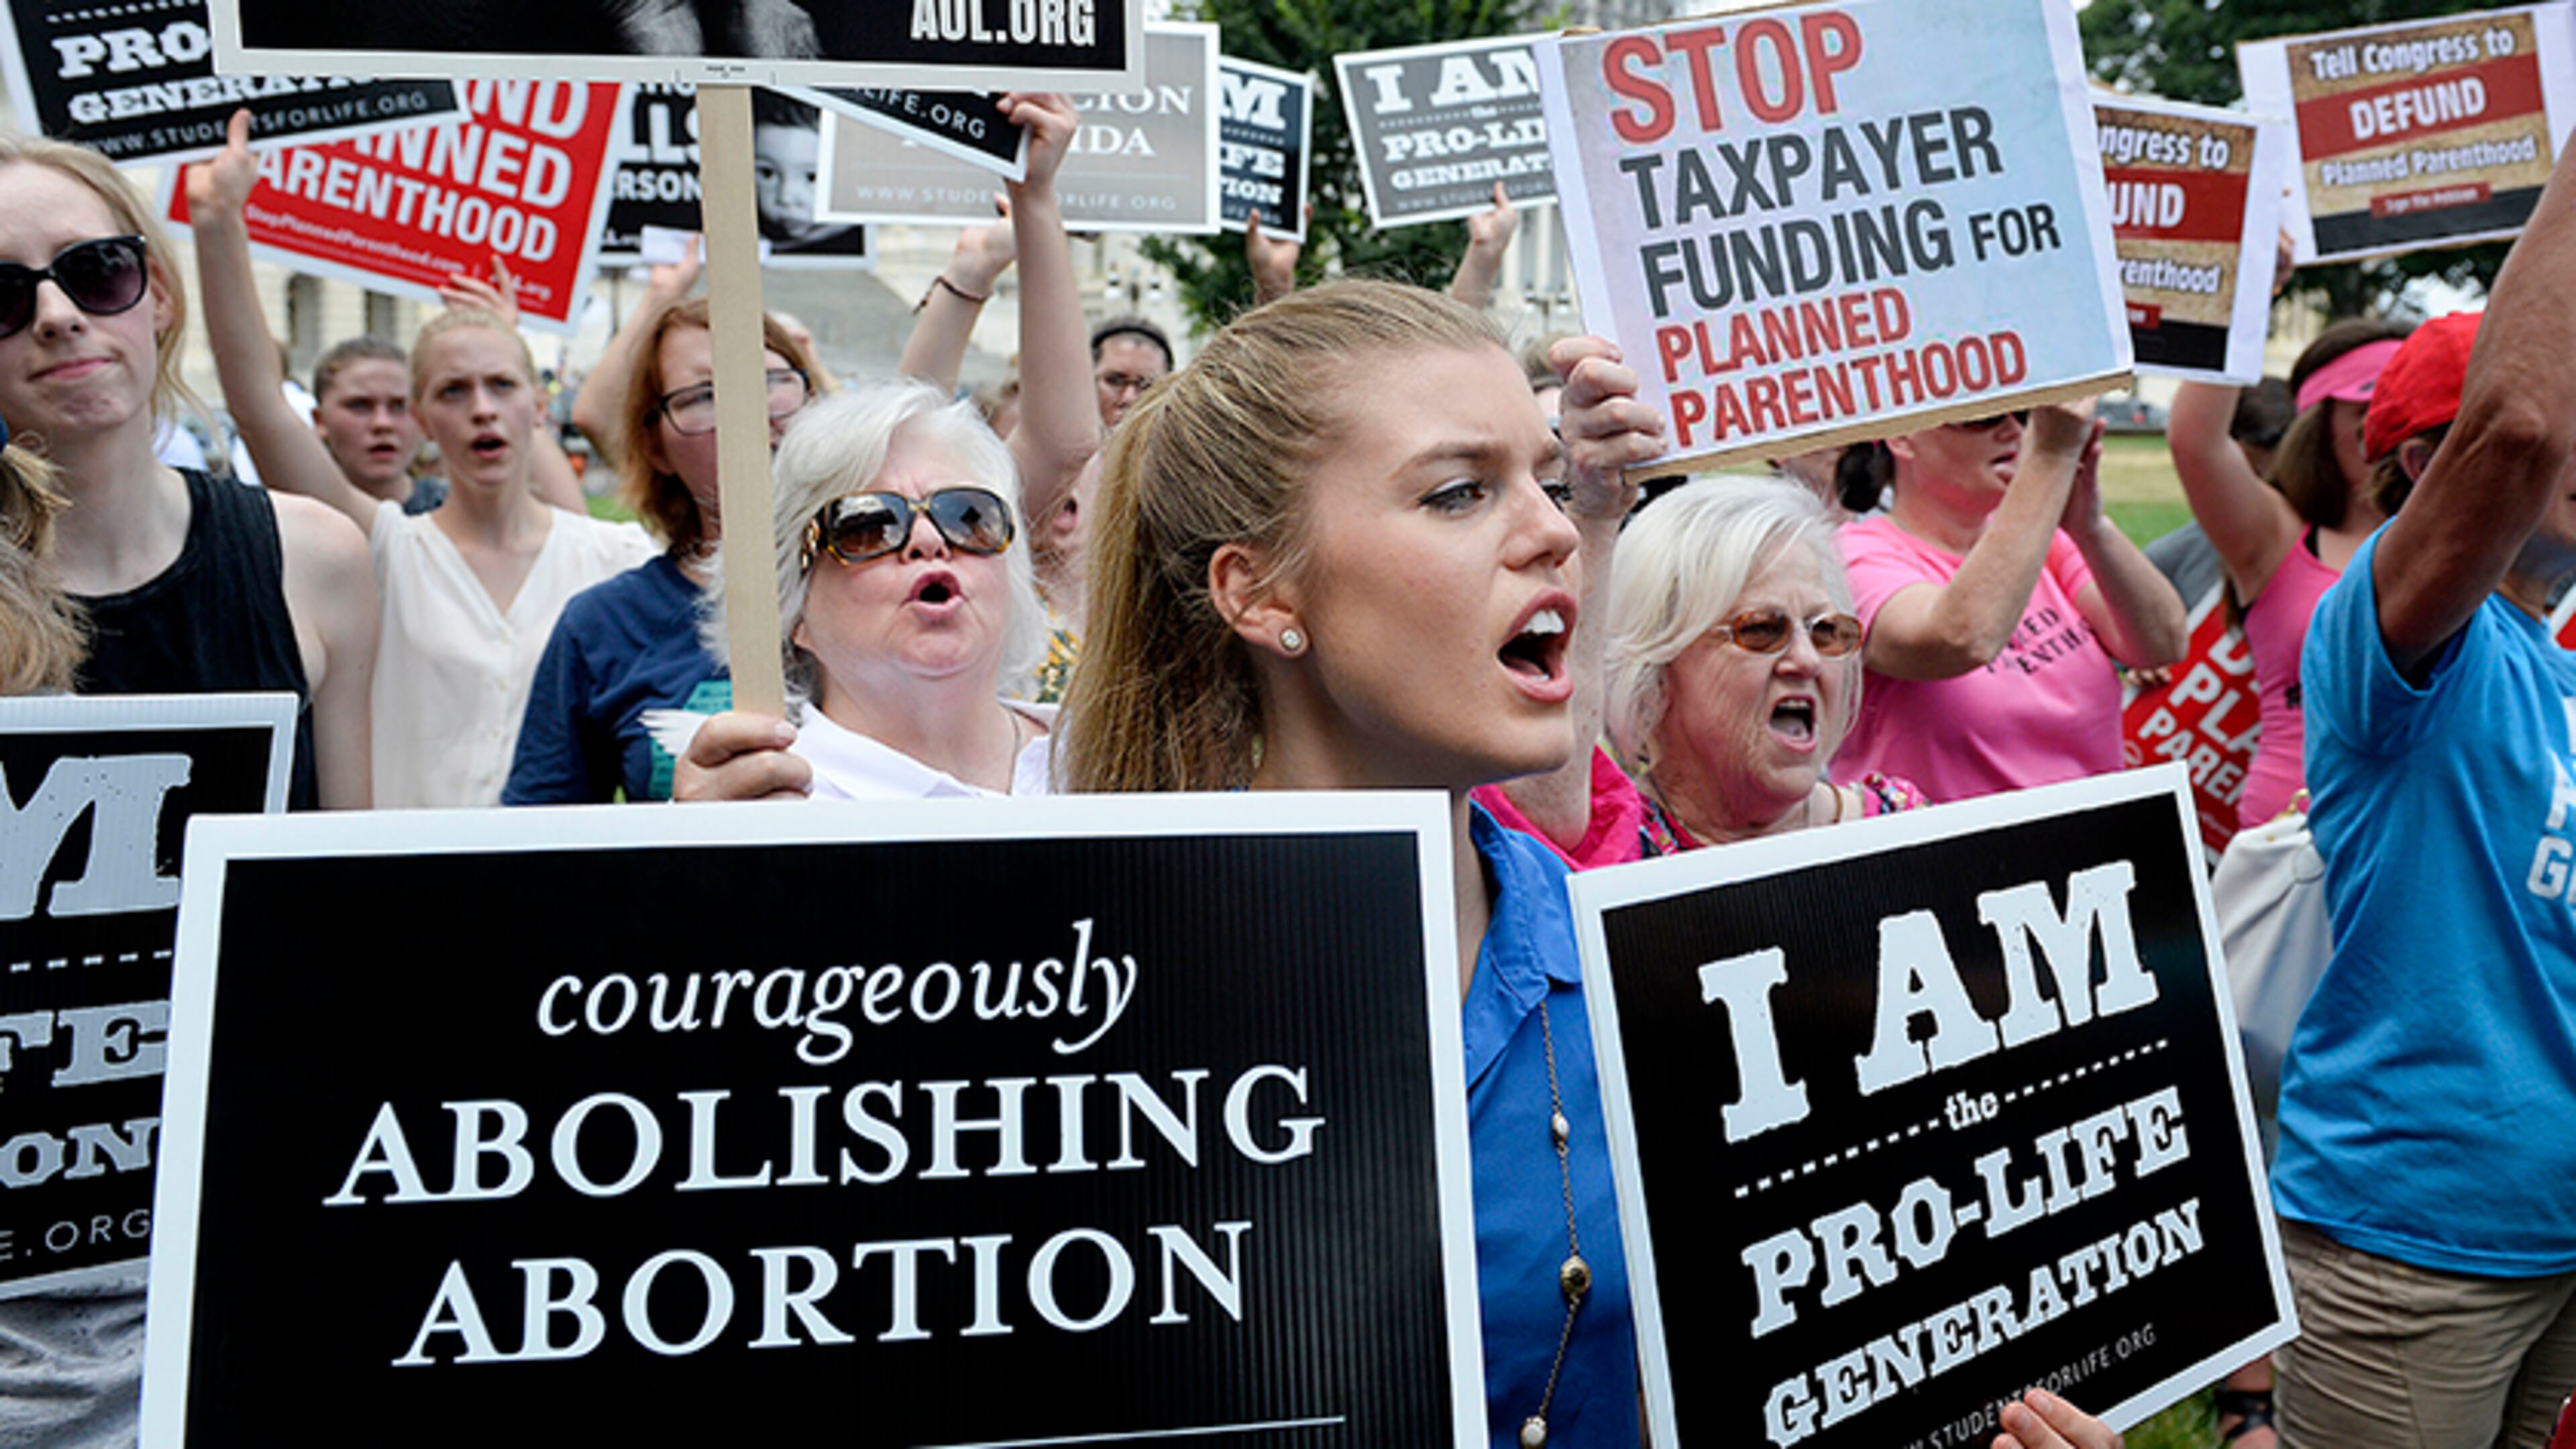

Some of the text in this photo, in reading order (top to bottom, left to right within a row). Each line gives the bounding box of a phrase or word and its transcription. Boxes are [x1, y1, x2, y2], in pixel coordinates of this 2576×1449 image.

[1075, 85, 1192, 114] ION
[1364, 64, 1412, 114] I
[1603, 11, 1863, 144] STOP
[2310, 27, 2515, 80] Tell Congress to
[2349, 76, 2486, 140] DEFUND
[1621, 106, 2004, 230] TAXPAYER
[2198, 131, 2230, 168] to
[2320, 134, 2538, 187] Planned Parenthood
[1639, 199, 2062, 319] FUNDING FOR
[1656, 286, 1911, 383] PLANNED
[1668, 329, 2028, 449] PARENTHOOD
[537, 917, 1138, 1065] courageously
[1698, 859, 2159, 1144] I AM
[323, 1063, 1325, 1207] ABOLISHING
[1943, 1091, 1999, 1131] the
[1741, 1085, 2191, 1339] PRO-LIFE
[390, 1220, 1254, 1369] ABORTION
[1762, 1198, 2206, 1449] GENERATION
